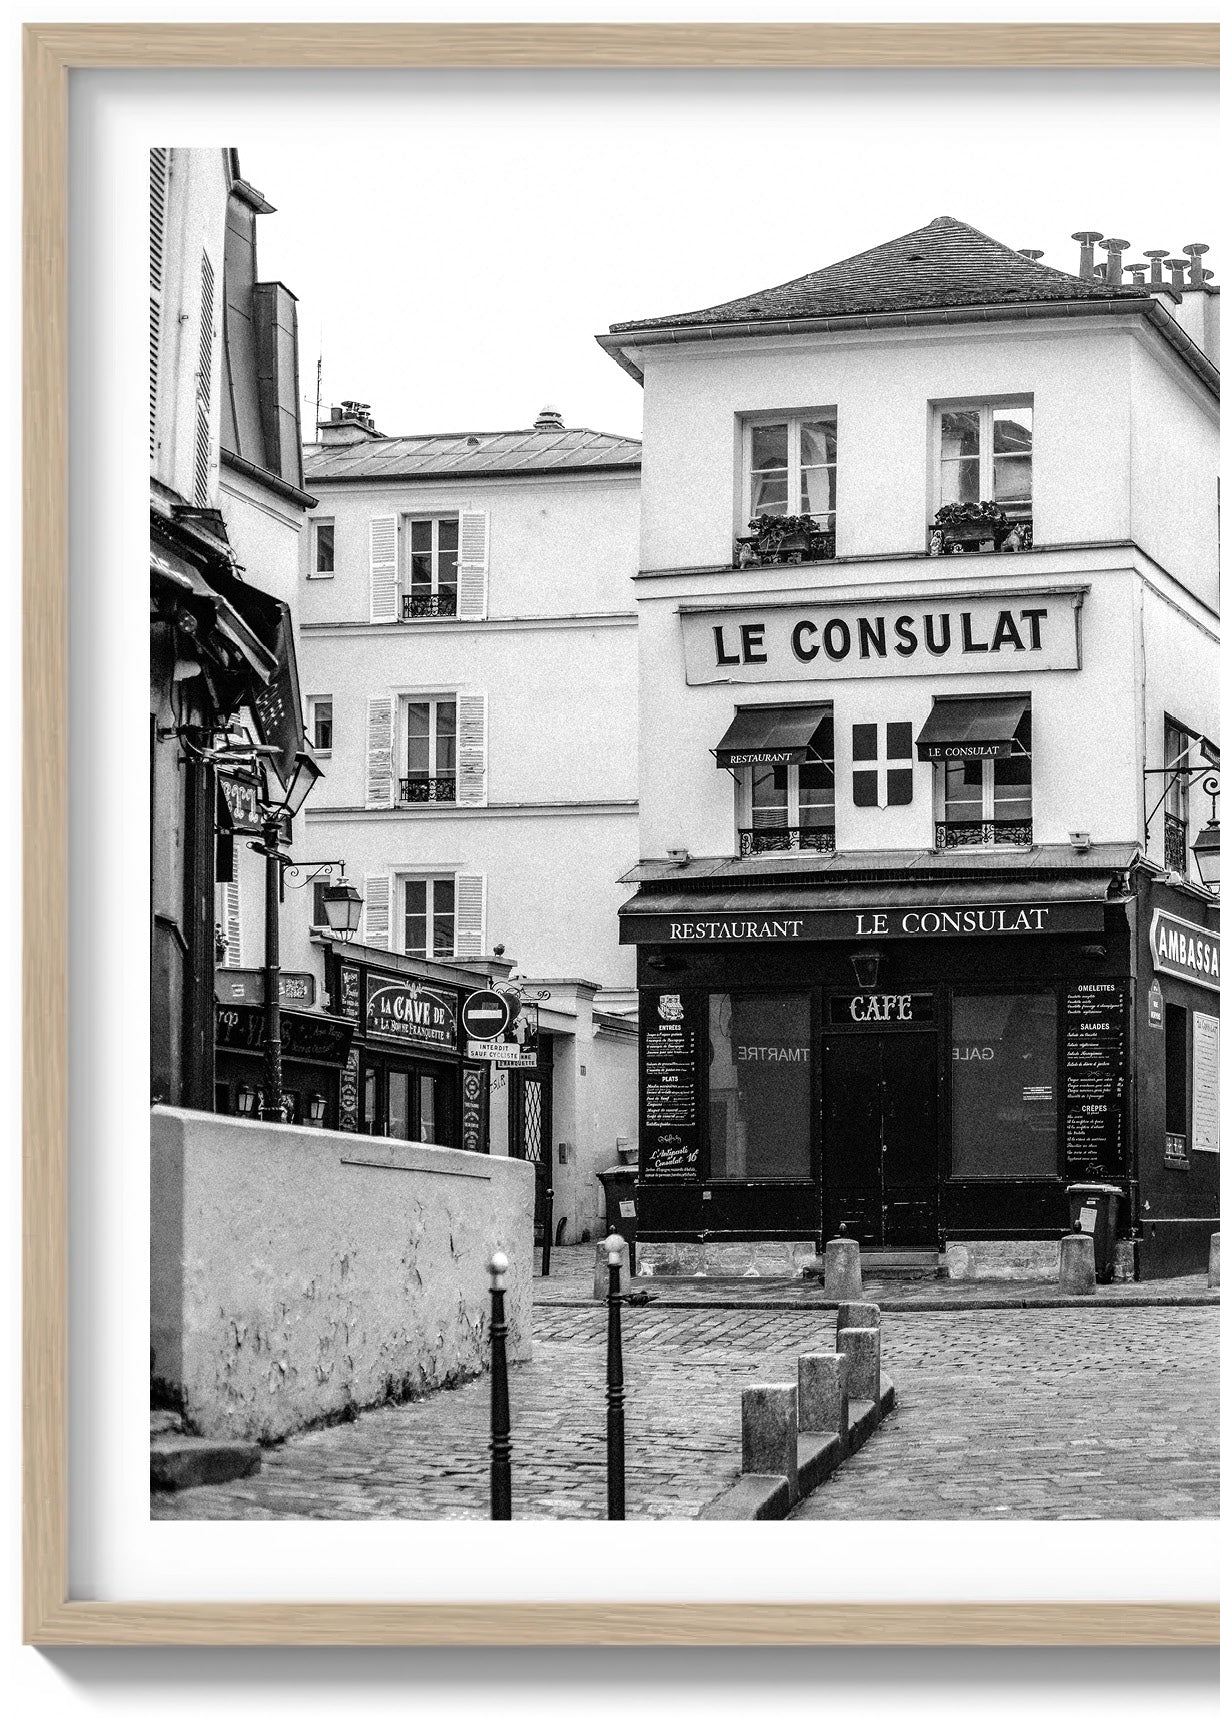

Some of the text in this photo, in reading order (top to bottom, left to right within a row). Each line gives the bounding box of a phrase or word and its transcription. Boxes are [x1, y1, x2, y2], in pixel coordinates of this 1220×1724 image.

[711, 608, 1048, 667] LE CONSULAT
[729, 752, 793, 764] RESTAURANT
[928, 745, 1000, 758] LE CONSULAT
[669, 919, 804, 941] RESTAURANT
[855, 908, 1050, 936] LE CONSULAT
[1078, 984, 1115, 992] OMELETTES
[381, 996, 445, 1026] LA CAVE DE
[489, 1051, 518, 1059] CYCLISTE
